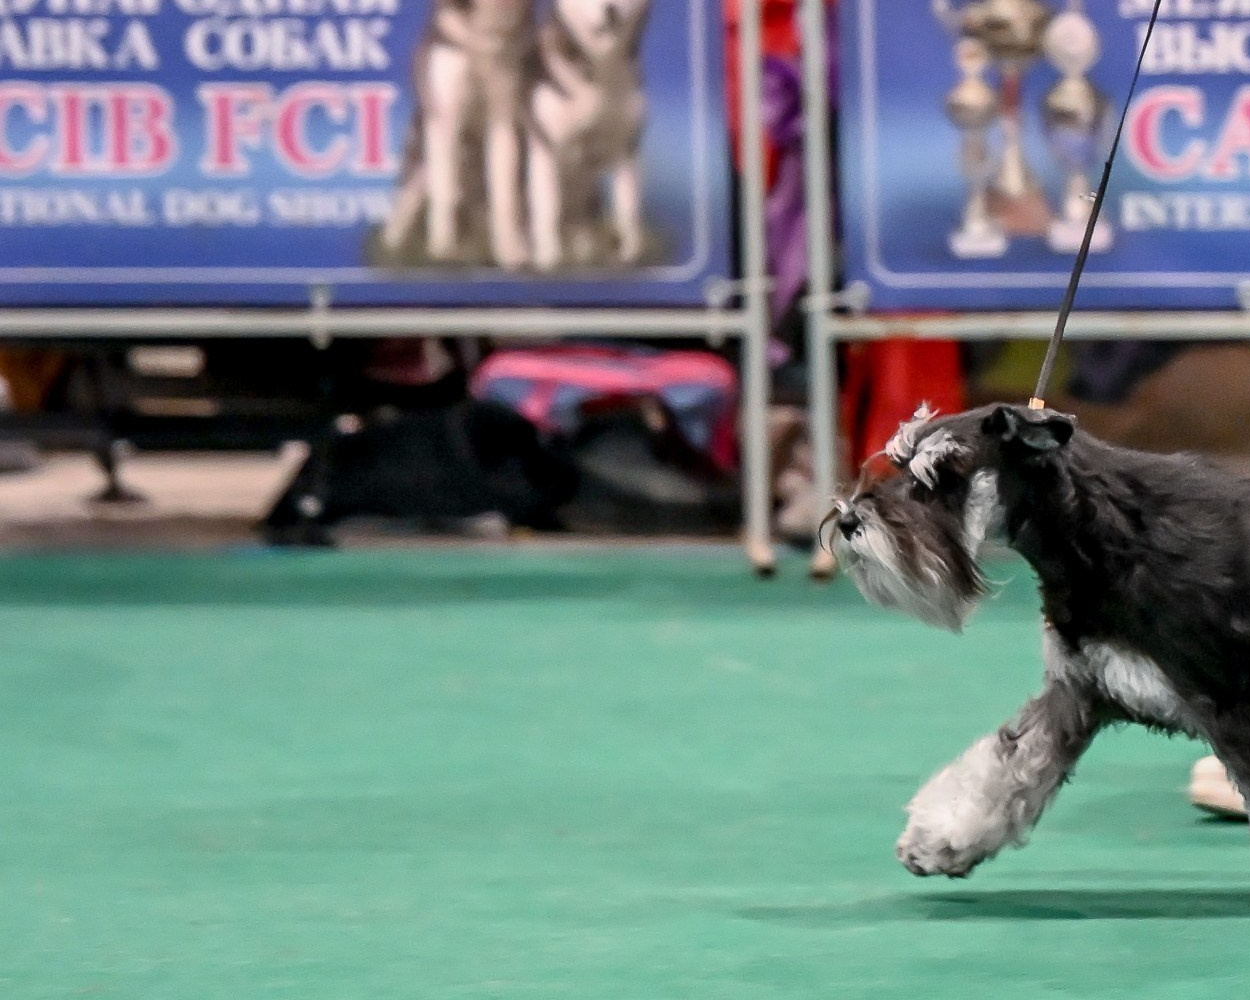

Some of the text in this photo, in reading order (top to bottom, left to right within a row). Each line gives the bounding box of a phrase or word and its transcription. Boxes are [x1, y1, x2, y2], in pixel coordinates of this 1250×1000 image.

[184, 18, 392, 71] СОБАК
[197, 80, 399, 179] FCI
[163, 188, 261, 228] DOG
